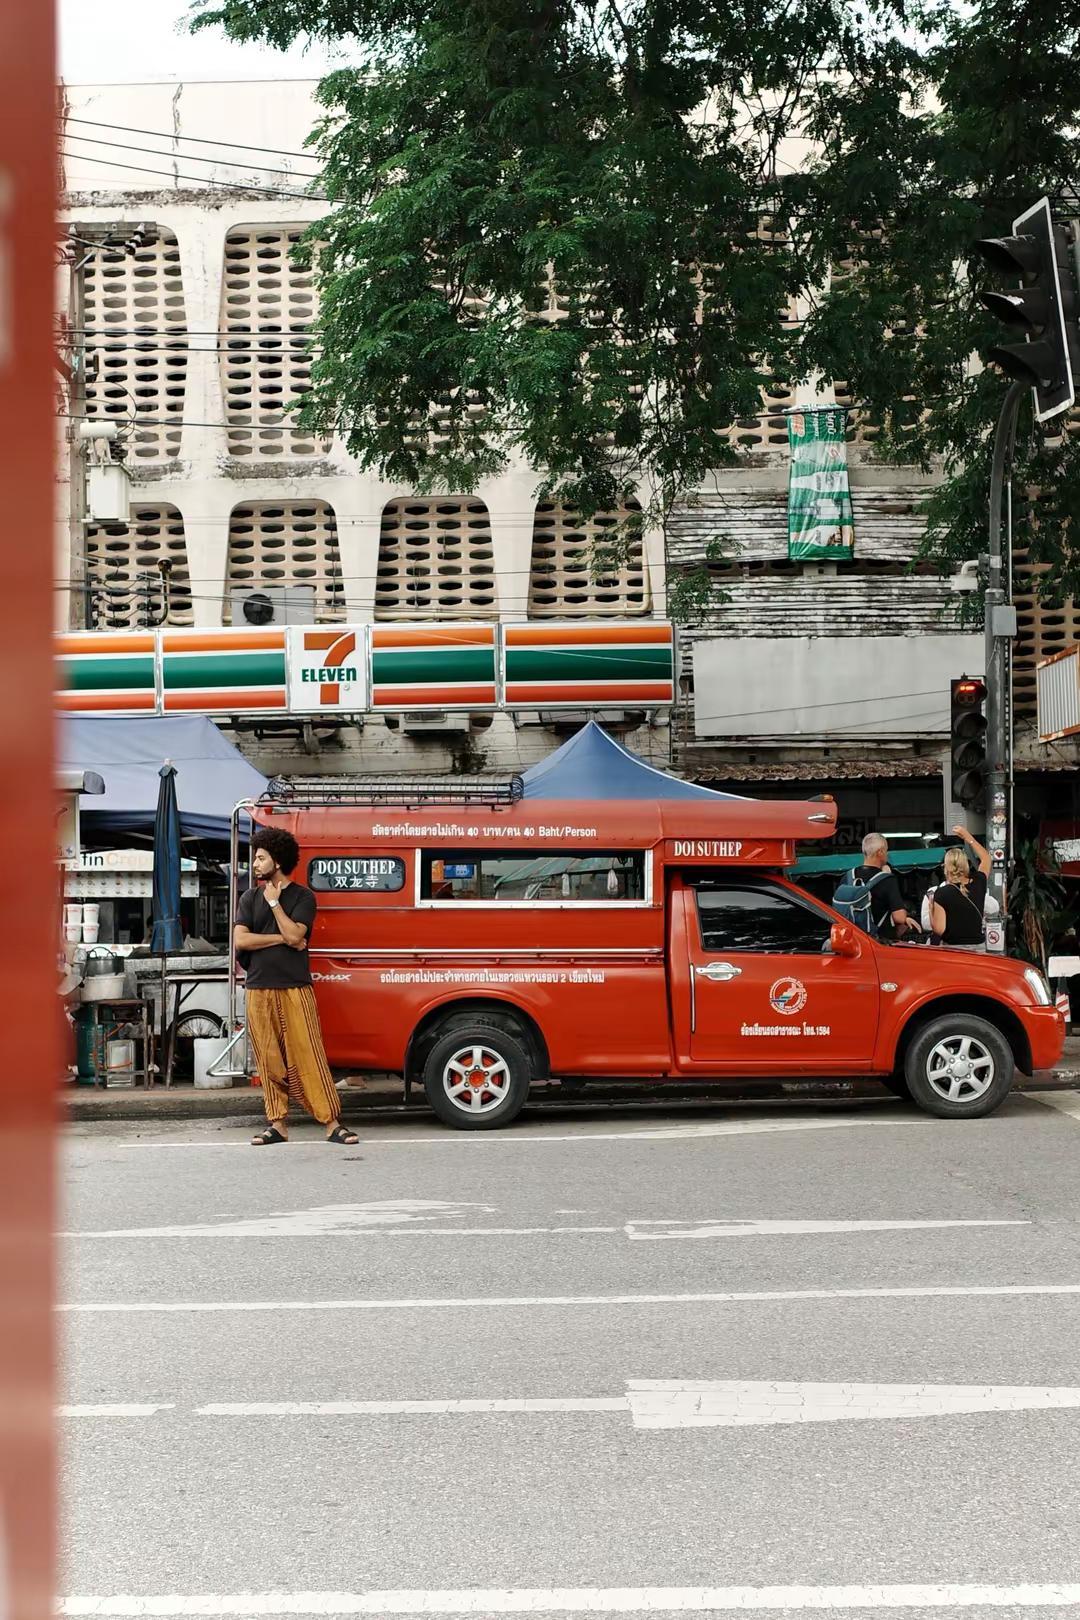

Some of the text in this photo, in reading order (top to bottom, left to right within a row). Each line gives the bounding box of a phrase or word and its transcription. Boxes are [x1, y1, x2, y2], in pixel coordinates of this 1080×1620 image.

[304, 631, 356, 705] 7
[467, 827, 479, 837] 40
[523, 826, 535, 837] 40
[538, 826, 597, 837] Baht/Person
[674, 841, 743, 857] DOI SUTHEP
[318, 860, 396, 875] DOI SUTHEP
[334, 875, 379, 888] 双龙寺
[560, 973, 567, 983] 2
[568, 969, 605, 983] เชียงใหม่
